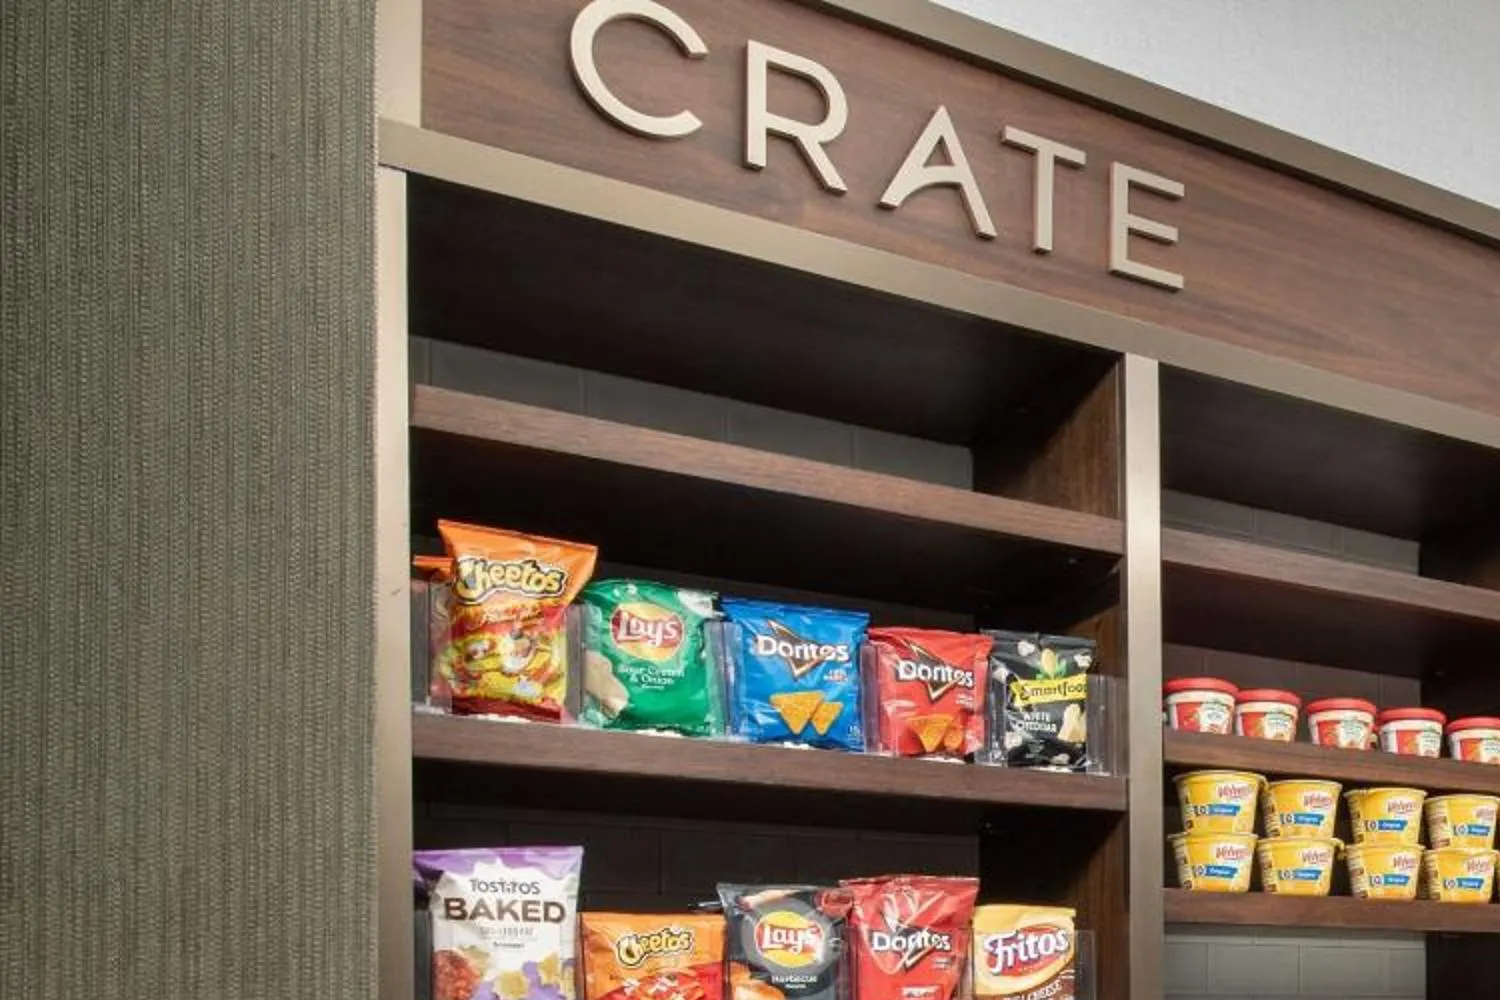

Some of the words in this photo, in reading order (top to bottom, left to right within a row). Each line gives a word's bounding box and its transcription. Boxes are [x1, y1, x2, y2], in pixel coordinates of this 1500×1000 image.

[570, 0, 1186, 291] CRATE
[456, 555, 566, 603] Cheetos
[614, 609, 683, 648] Lay's
[755, 634, 850, 662] Doritos
[898, 659, 975, 688] Doritos
[469, 877, 541, 895] TOSTITOS
[443, 898, 566, 924] BAKED
[616, 926, 693, 967] Cheetos
[760, 924, 822, 960] Lay's
[871, 931, 952, 951] Doritos
[983, 927, 1070, 975] Fritos
